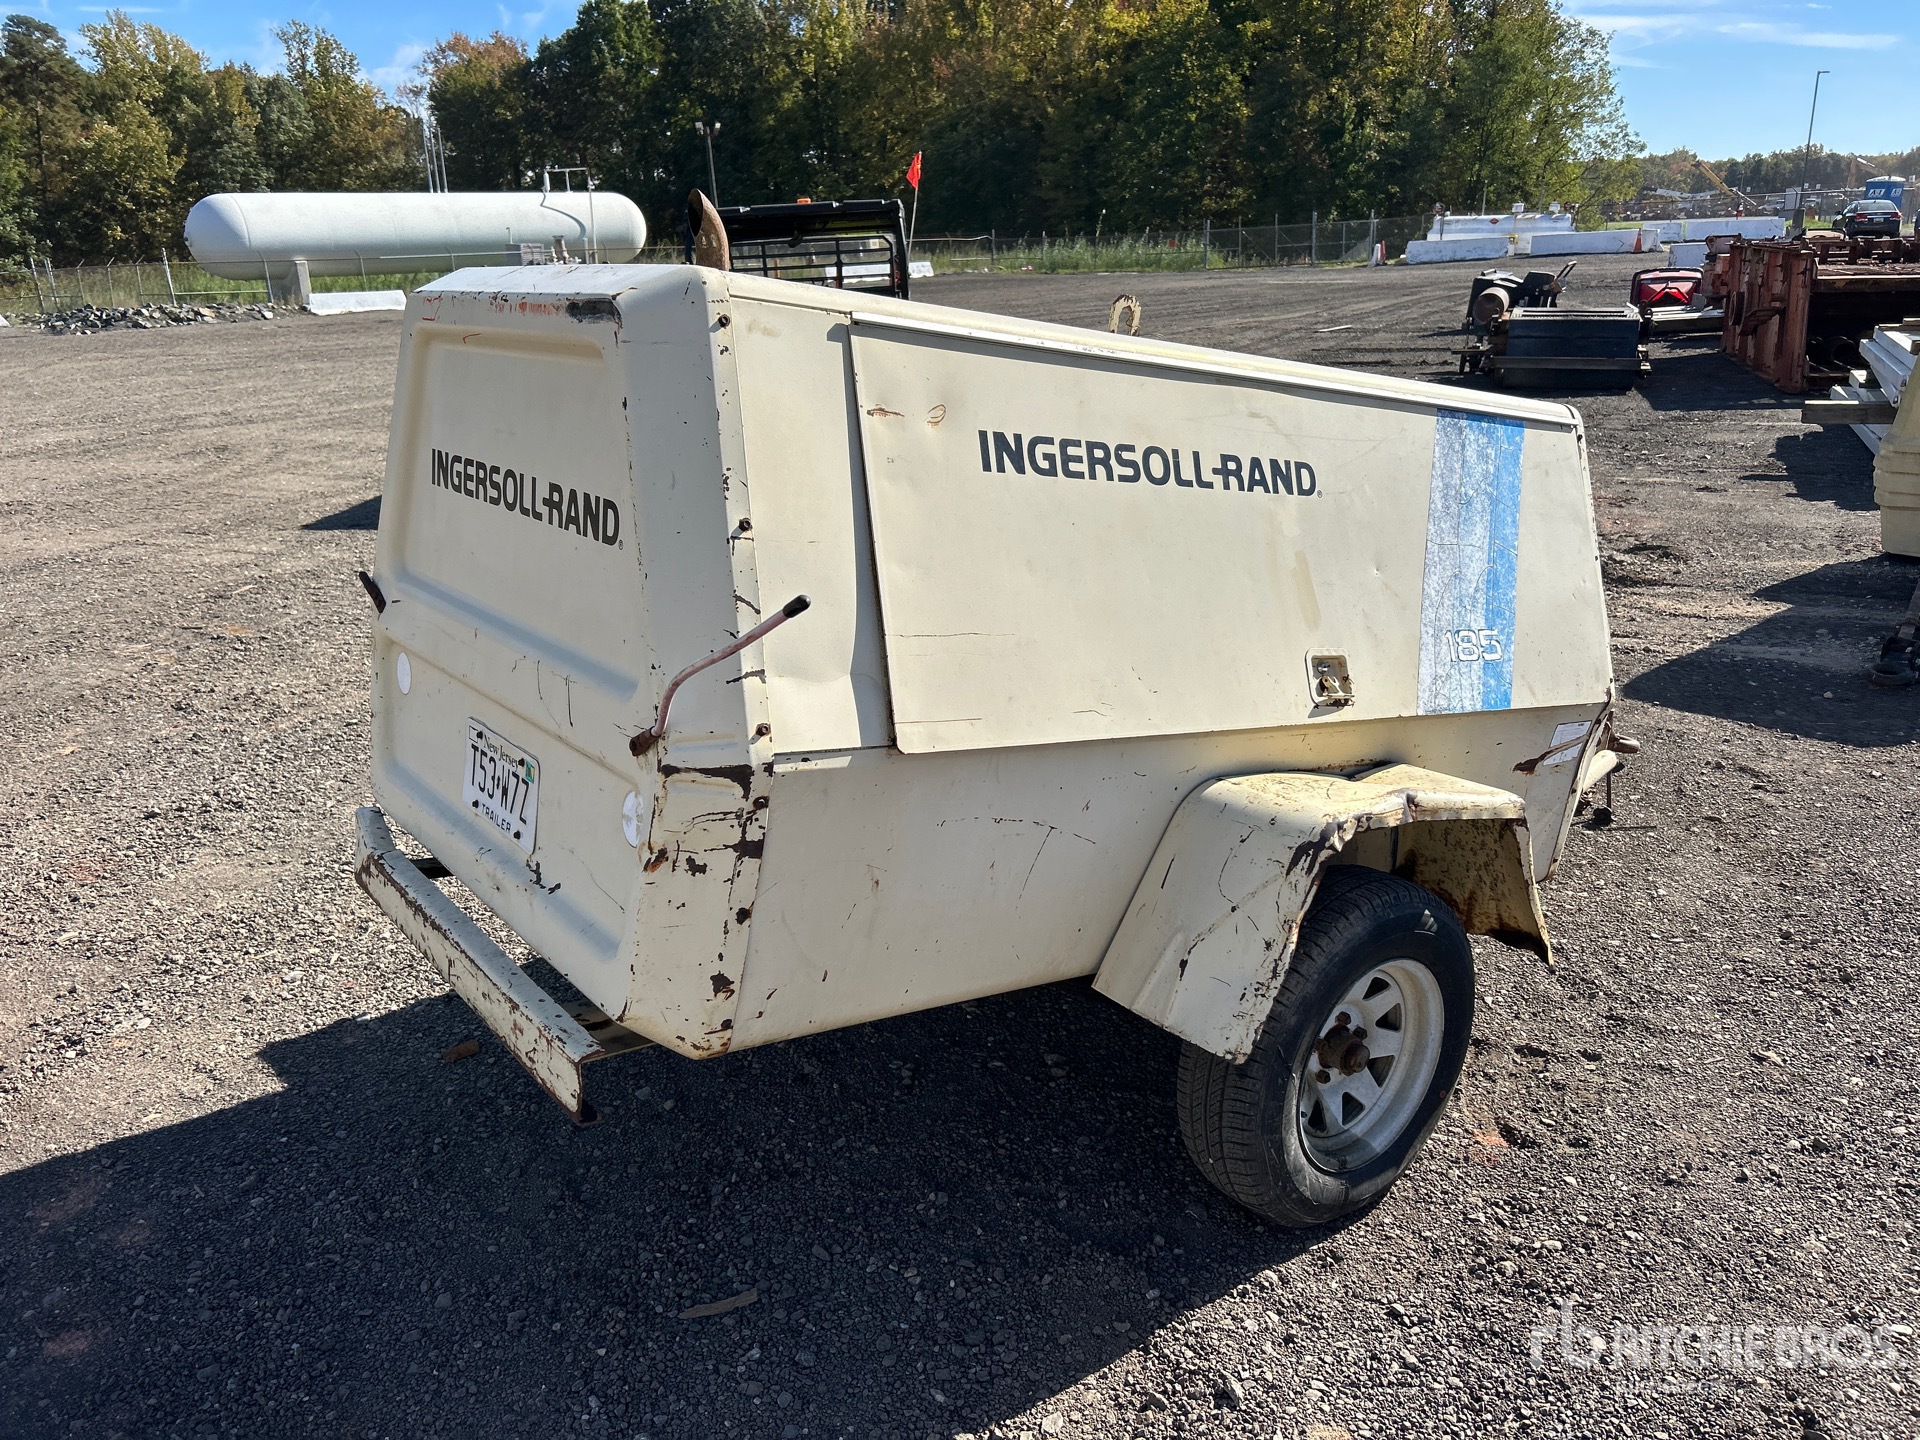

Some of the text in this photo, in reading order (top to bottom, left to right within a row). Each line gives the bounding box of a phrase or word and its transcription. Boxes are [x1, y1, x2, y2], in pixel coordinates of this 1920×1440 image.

[978, 429, 1317, 497] INGERSOLL-RAND
[431, 448, 620, 546] INGERSOLL-RAND
[1444, 628, 1502, 662] 185
[484, 734, 519, 772] New Jersey
[482, 802, 511, 834] TRAILER
